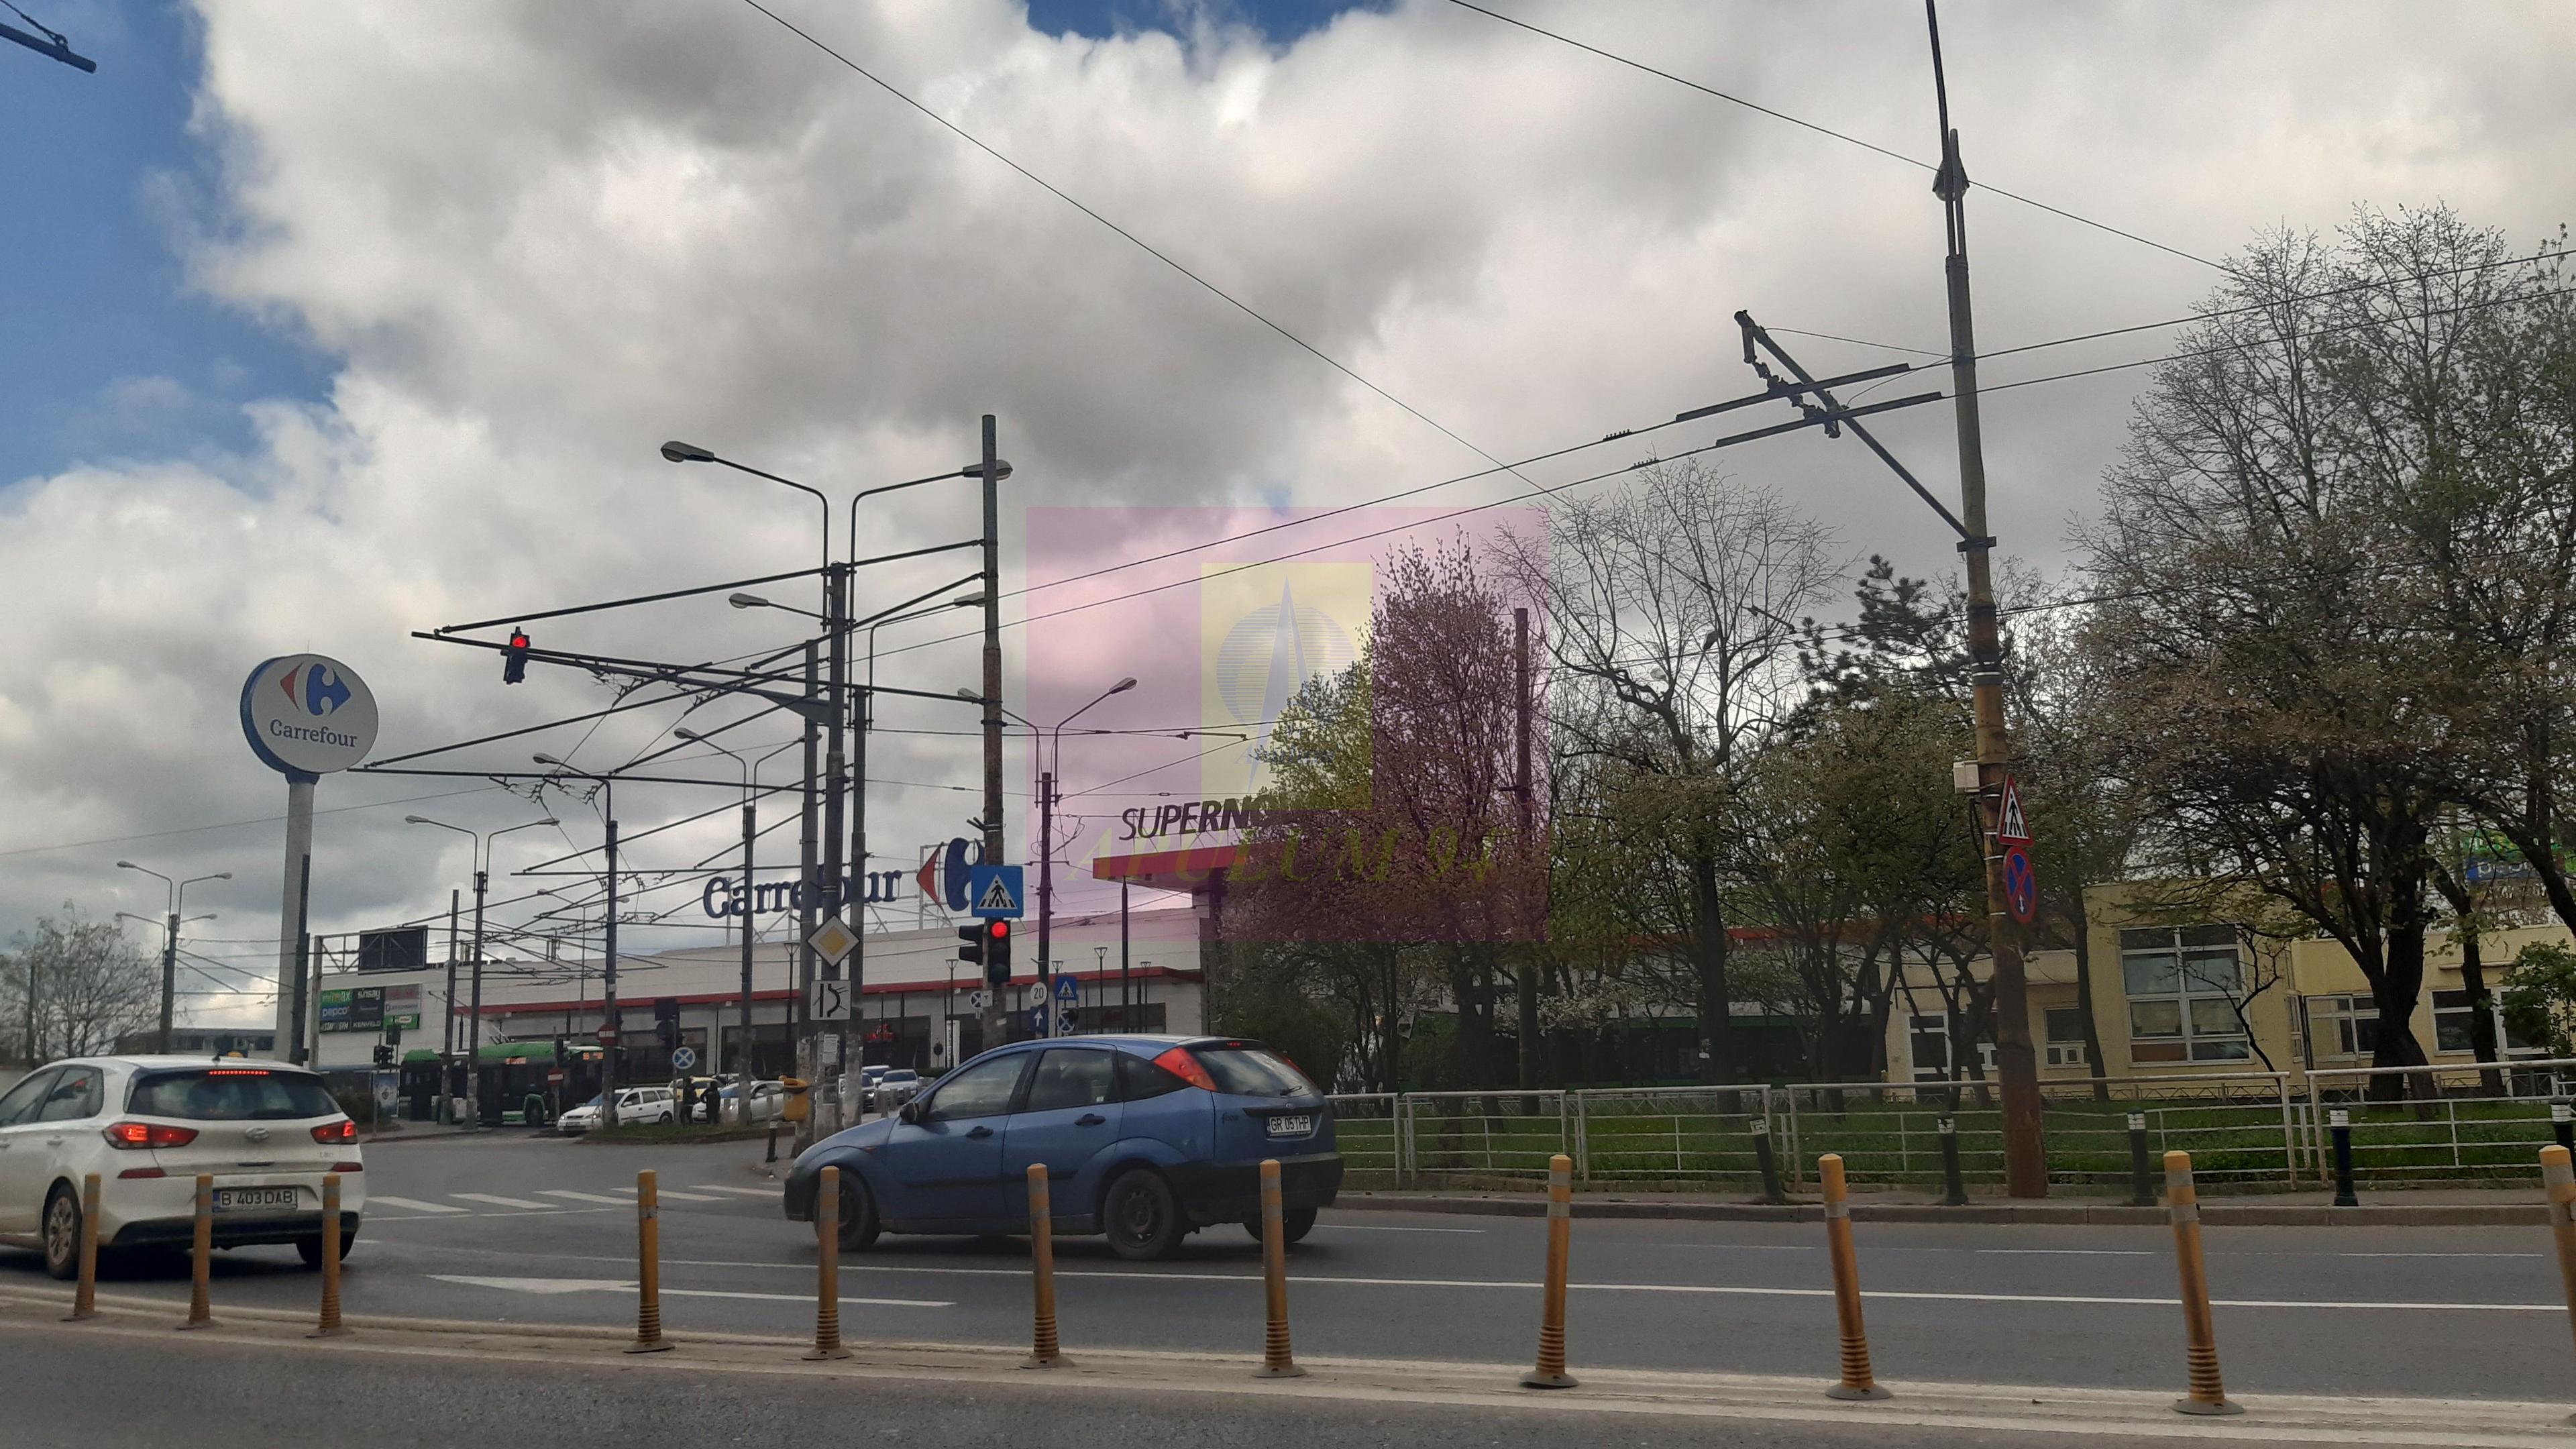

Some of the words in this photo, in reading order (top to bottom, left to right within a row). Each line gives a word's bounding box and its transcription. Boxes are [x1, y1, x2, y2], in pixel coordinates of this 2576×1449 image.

[270, 719, 358, 748] Carrefour
[1118, 793, 1280, 841] SUPERNO
[703, 864, 902, 919] Carreur
[358, 988, 381, 1000] sinsay
[1034, 987, 1044, 1000] 20
[322, 1007, 348, 1017] pepco
[1271, 1118, 1283, 1131] GR
[221, 1192, 231, 1205] B
[237, 1191, 262, 1205] 403
[265, 1191, 292, 1204] DAB
